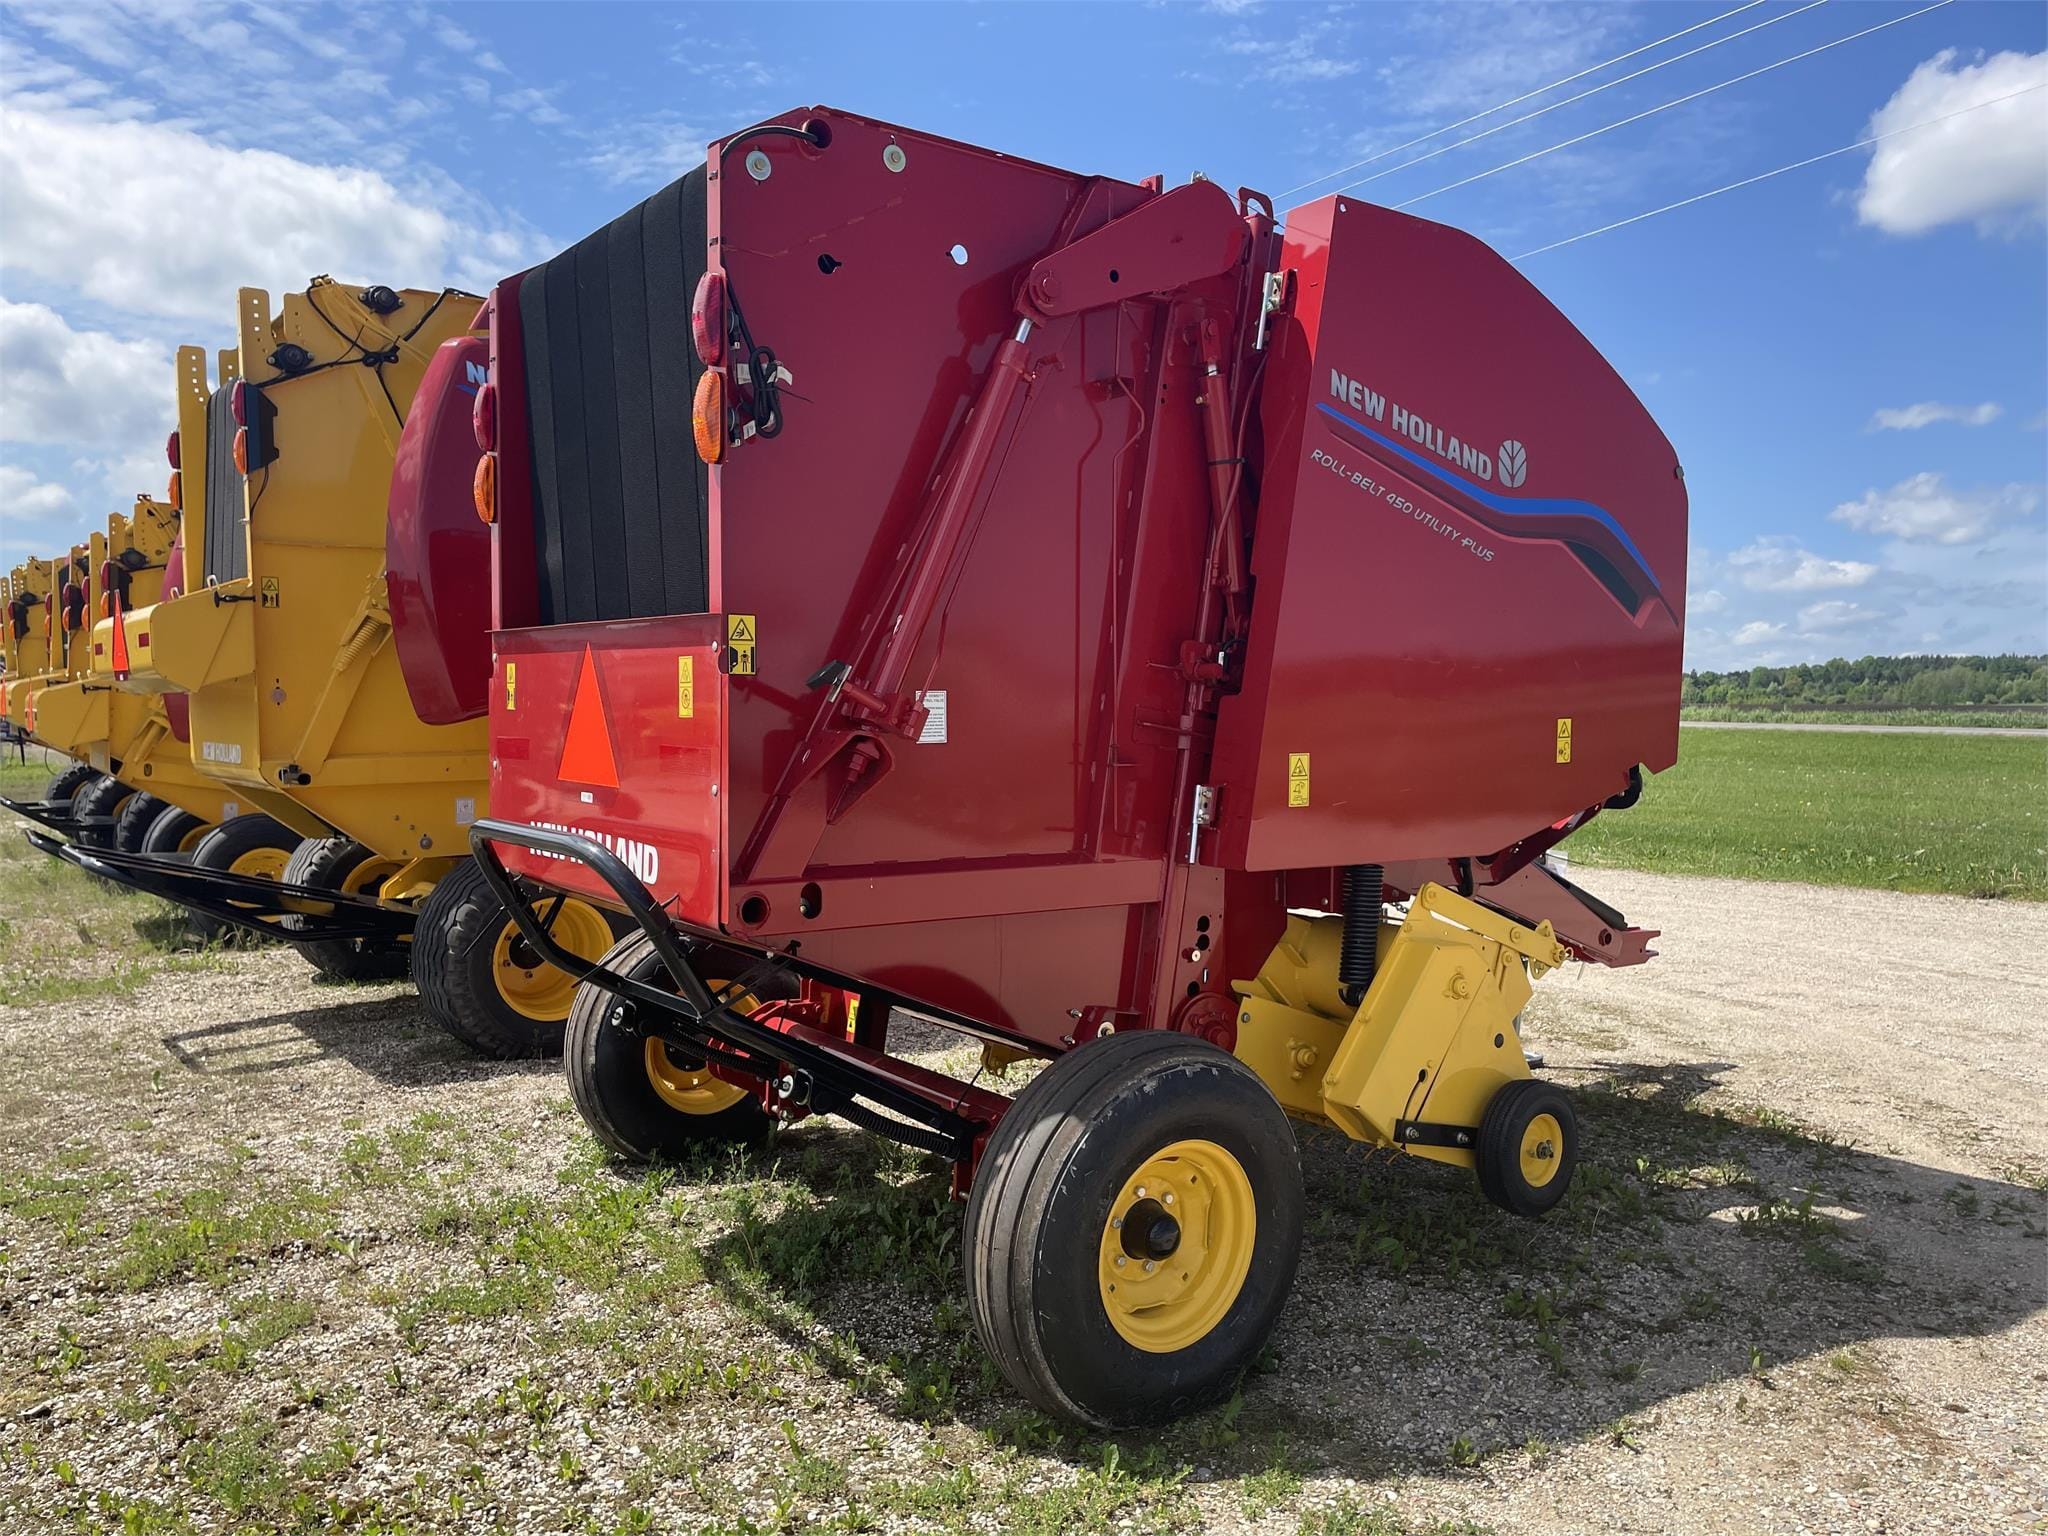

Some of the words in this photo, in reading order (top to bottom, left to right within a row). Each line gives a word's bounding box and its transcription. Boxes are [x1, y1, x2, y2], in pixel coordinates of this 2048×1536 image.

[465, 360, 490, 384] N
[1330, 368, 1386, 422] NEW
[1391, 403, 1493, 481] HOLLAND
[1310, 449, 1386, 497] ROLL-BELT
[1386, 493, 1413, 514] 450
[1414, 508, 1461, 541] UTILITY
